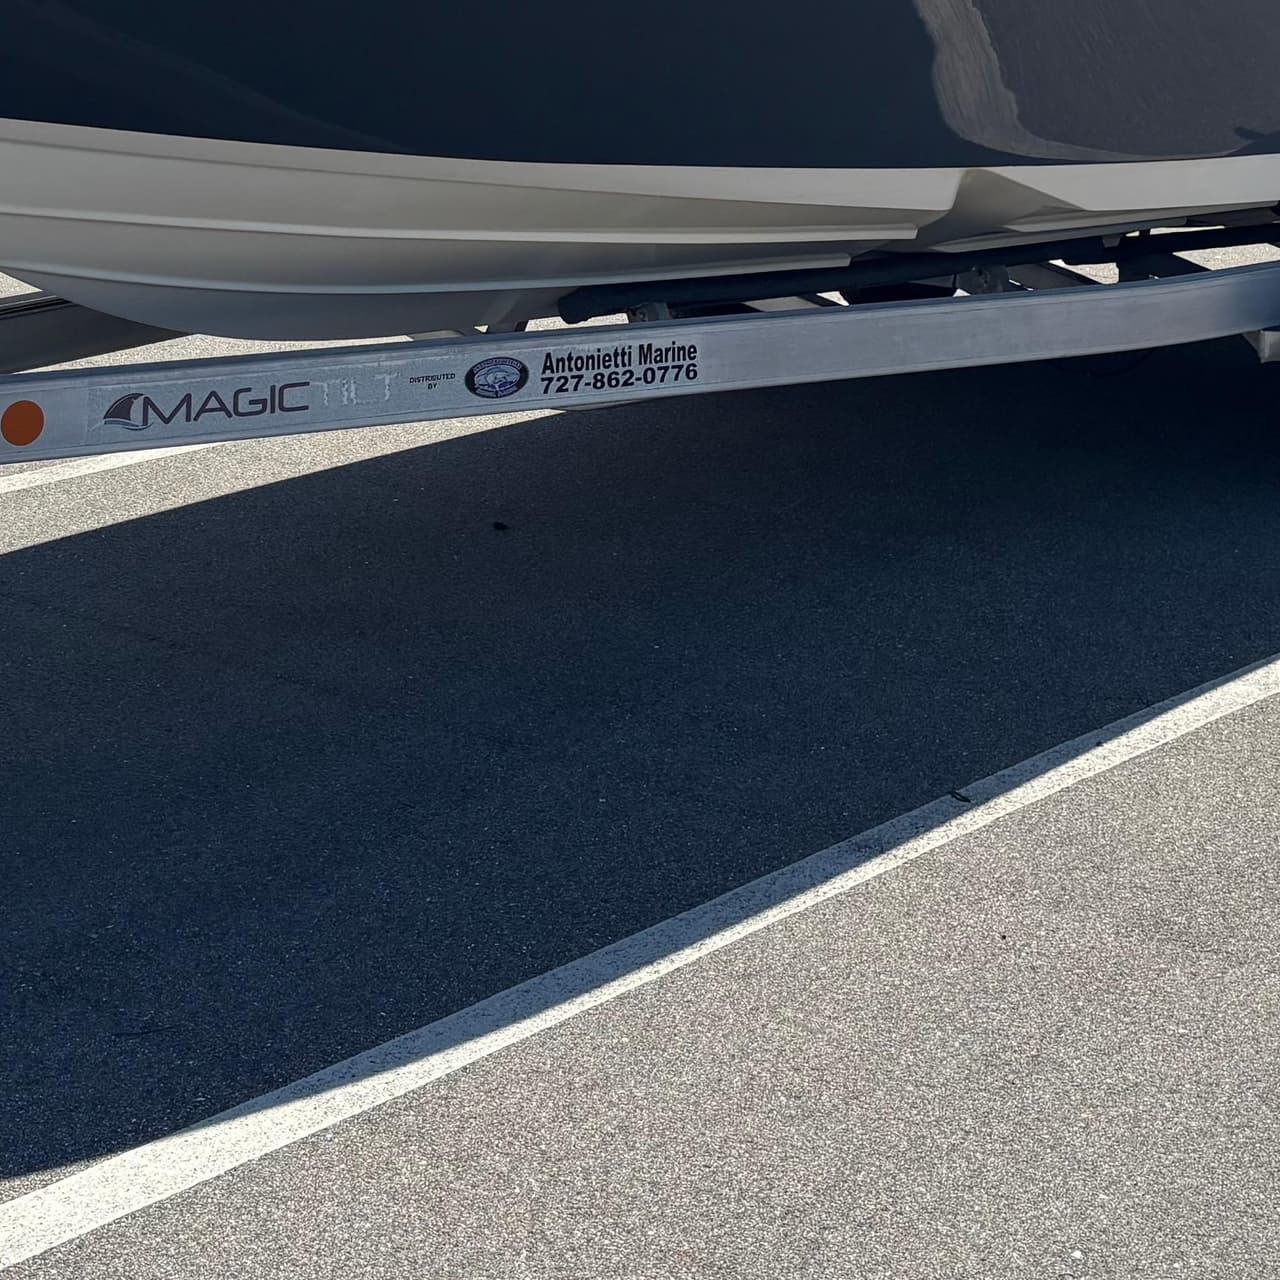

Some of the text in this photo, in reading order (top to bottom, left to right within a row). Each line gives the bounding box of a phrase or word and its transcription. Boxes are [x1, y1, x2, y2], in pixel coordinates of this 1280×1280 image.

[541, 345, 632, 375] Antonietti
[638, 340, 698, 366] Marine
[541, 363, 698, 395] 727-862-0776
[143, 381, 310, 426] MAGIC
